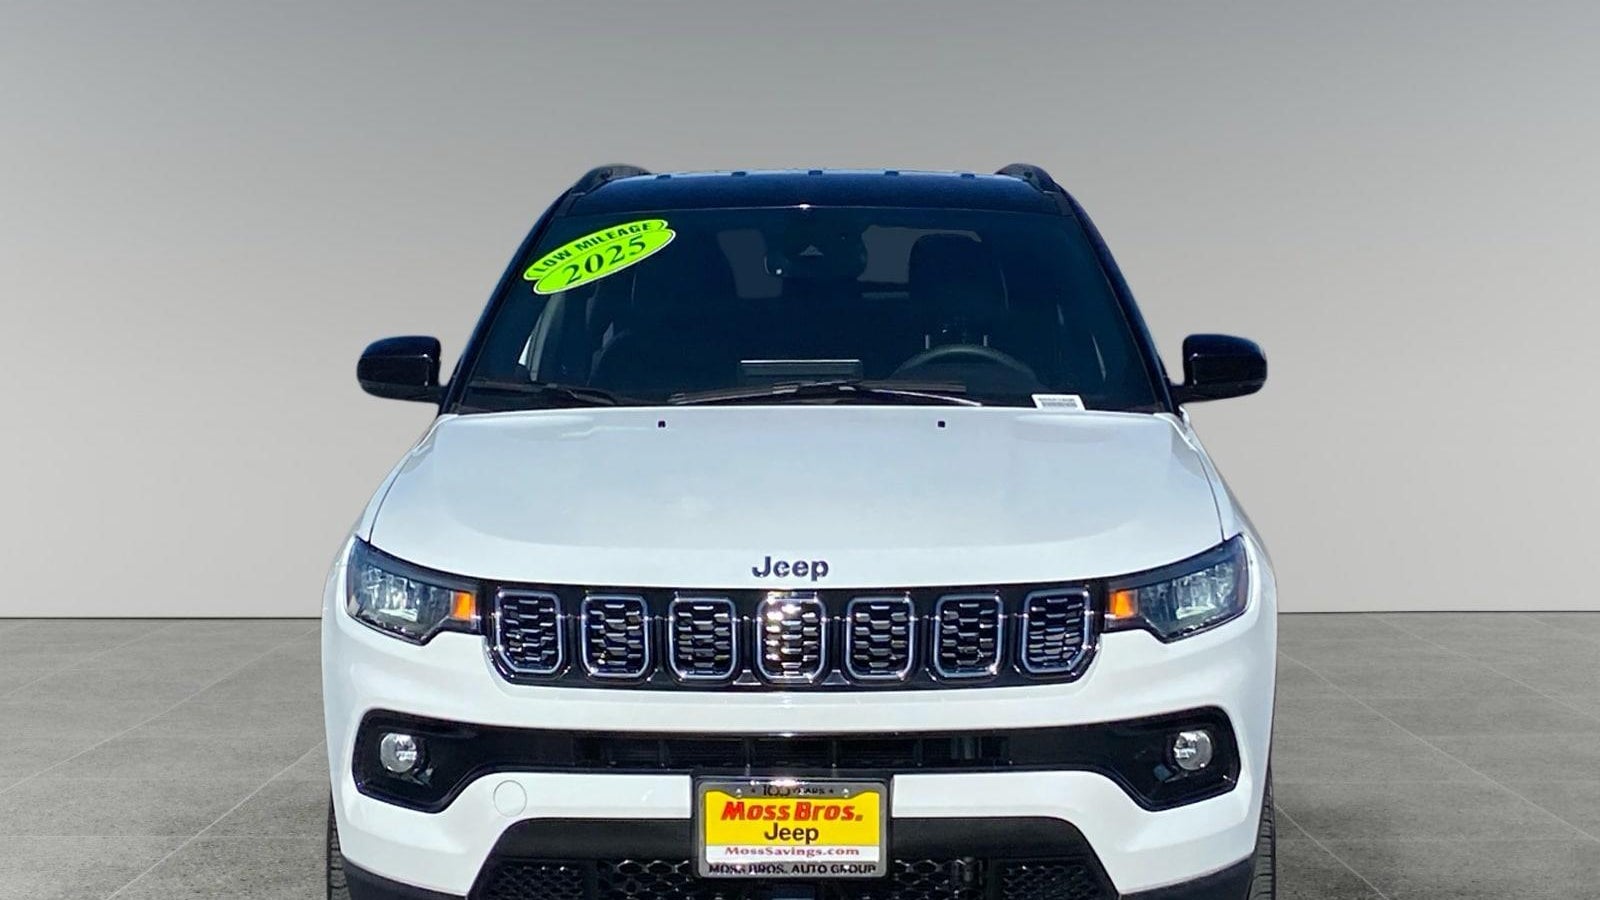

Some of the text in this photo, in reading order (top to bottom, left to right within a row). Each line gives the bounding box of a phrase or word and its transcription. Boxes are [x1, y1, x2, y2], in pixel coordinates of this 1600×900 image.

[533, 223, 651, 273] LOW MILEAGE
[563, 234, 647, 285] 2025
[752, 556, 829, 582] Jeep
[721, 801, 863, 821] Moss Bros.
[764, 823, 819, 844] Jeep
[725, 846, 860, 857] MossSavings.com
[792, 864, 828, 874] AUTO
[831, 864, 876, 874] GROUP
